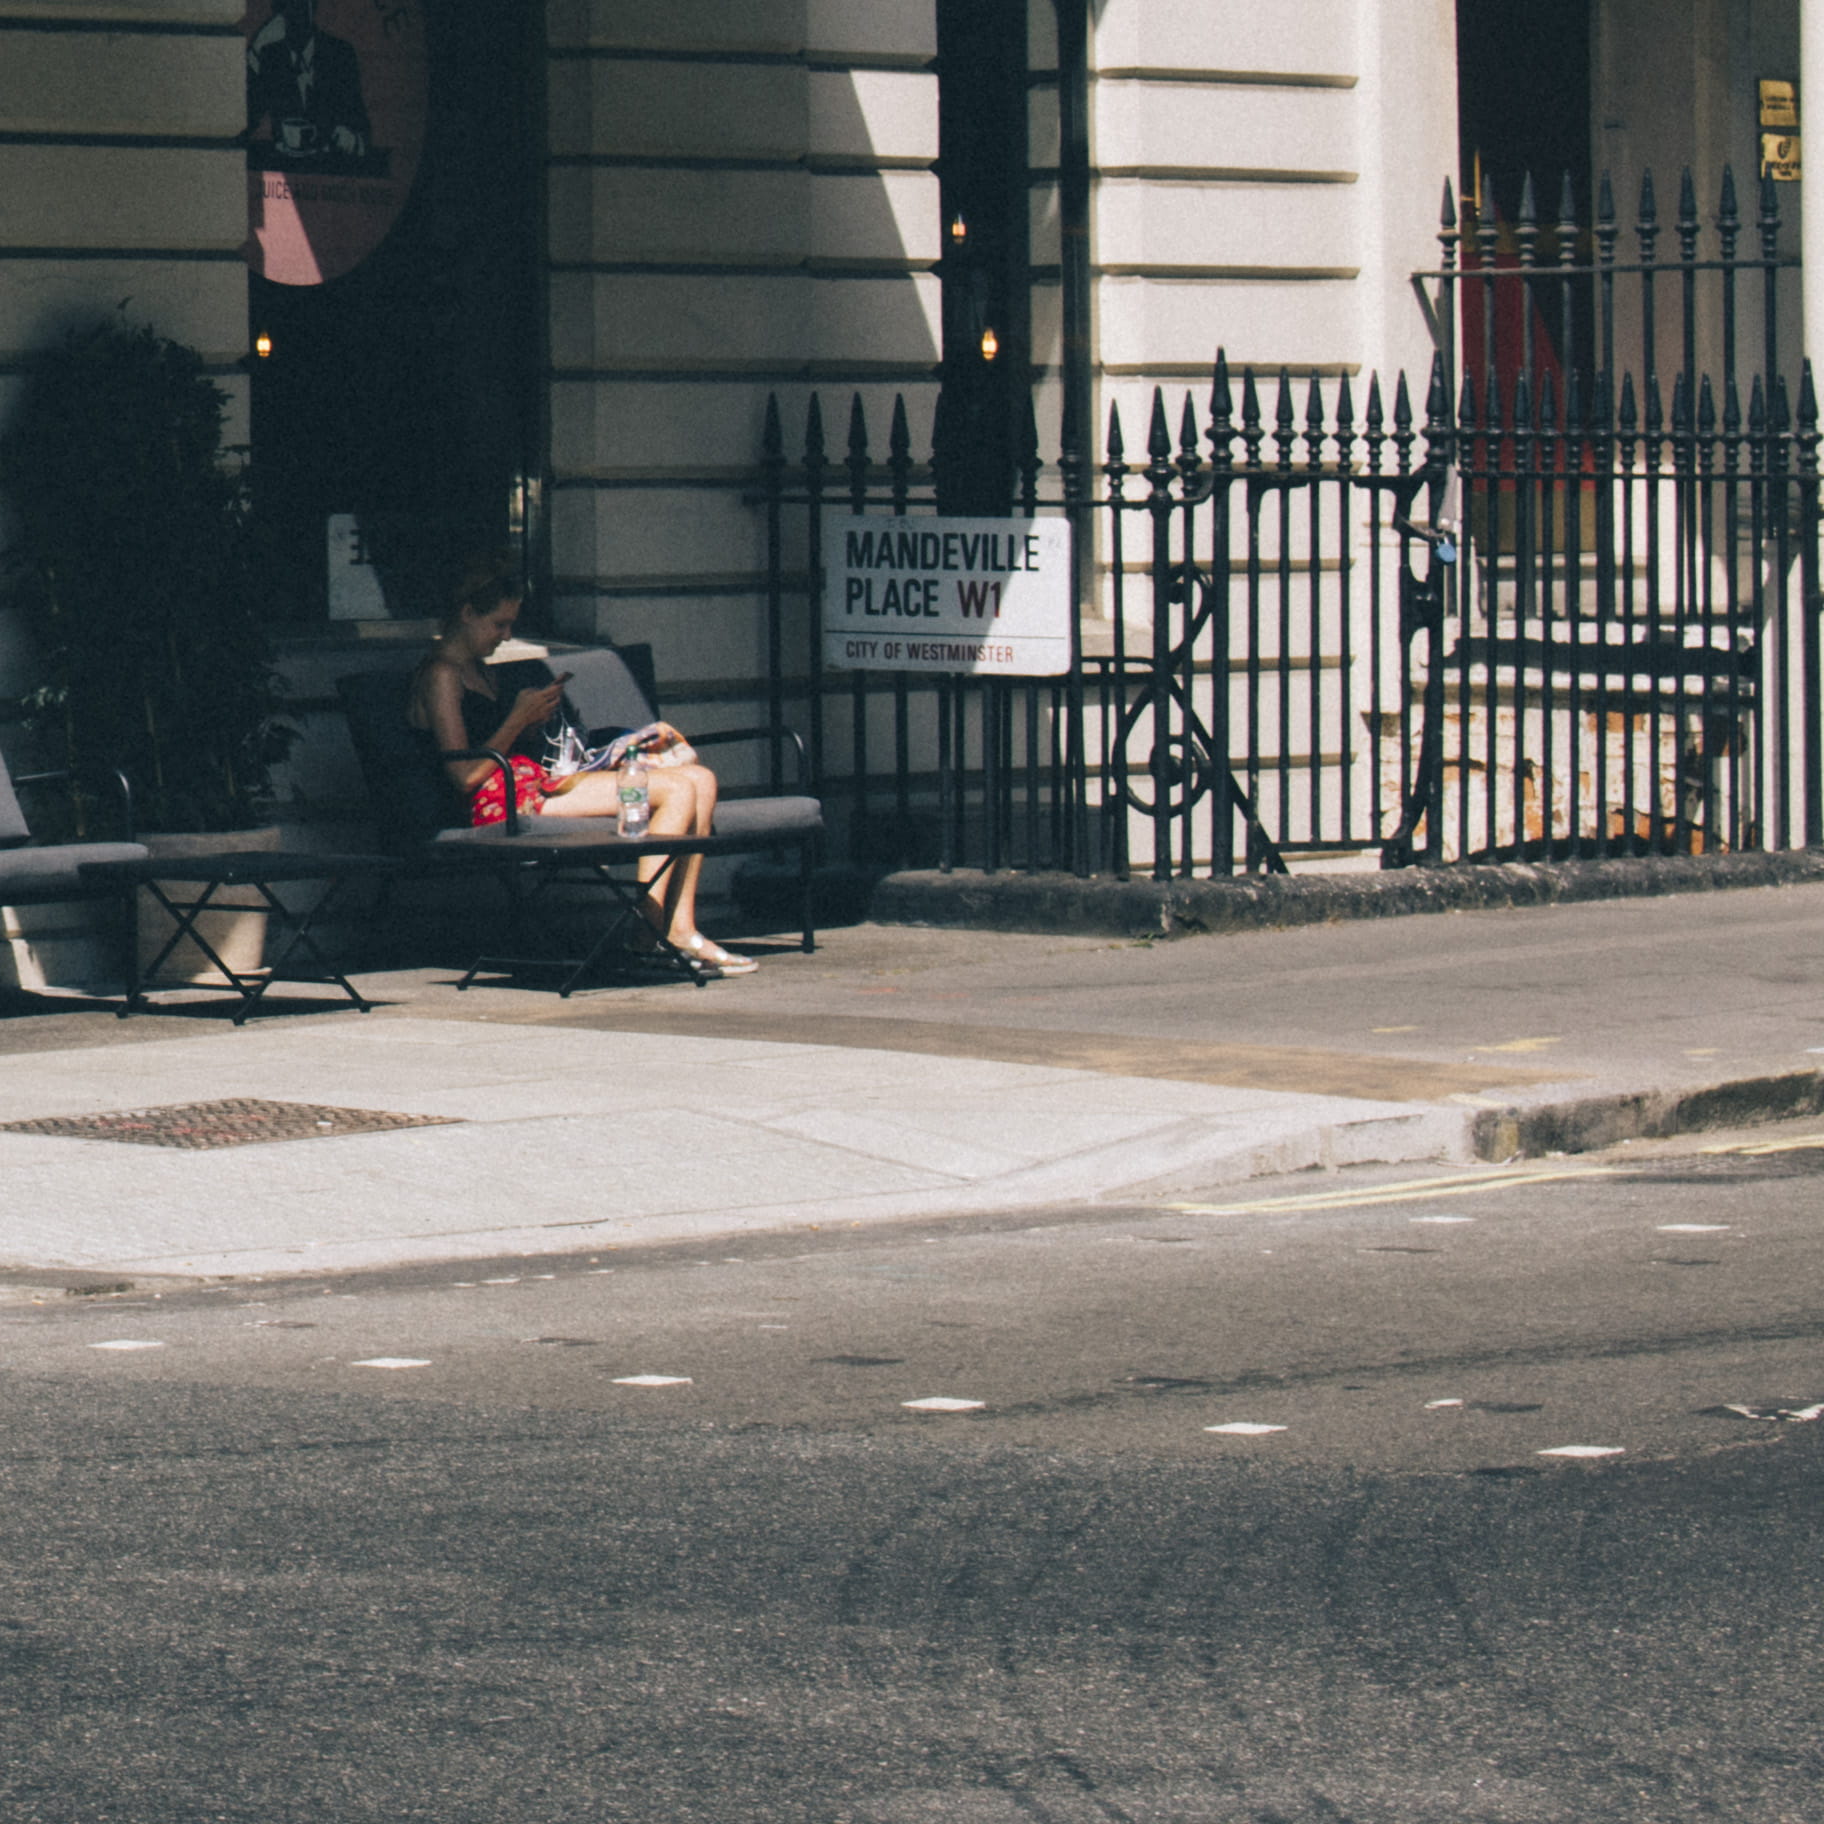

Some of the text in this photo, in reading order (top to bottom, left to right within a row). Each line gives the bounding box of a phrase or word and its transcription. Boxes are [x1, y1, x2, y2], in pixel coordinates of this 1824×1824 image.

[846, 531, 1039, 572] MANDEVILLE
[846, 577, 1002, 619] PLACE W1
[846, 641, 1014, 663] CITY OF WESTMINSTER
